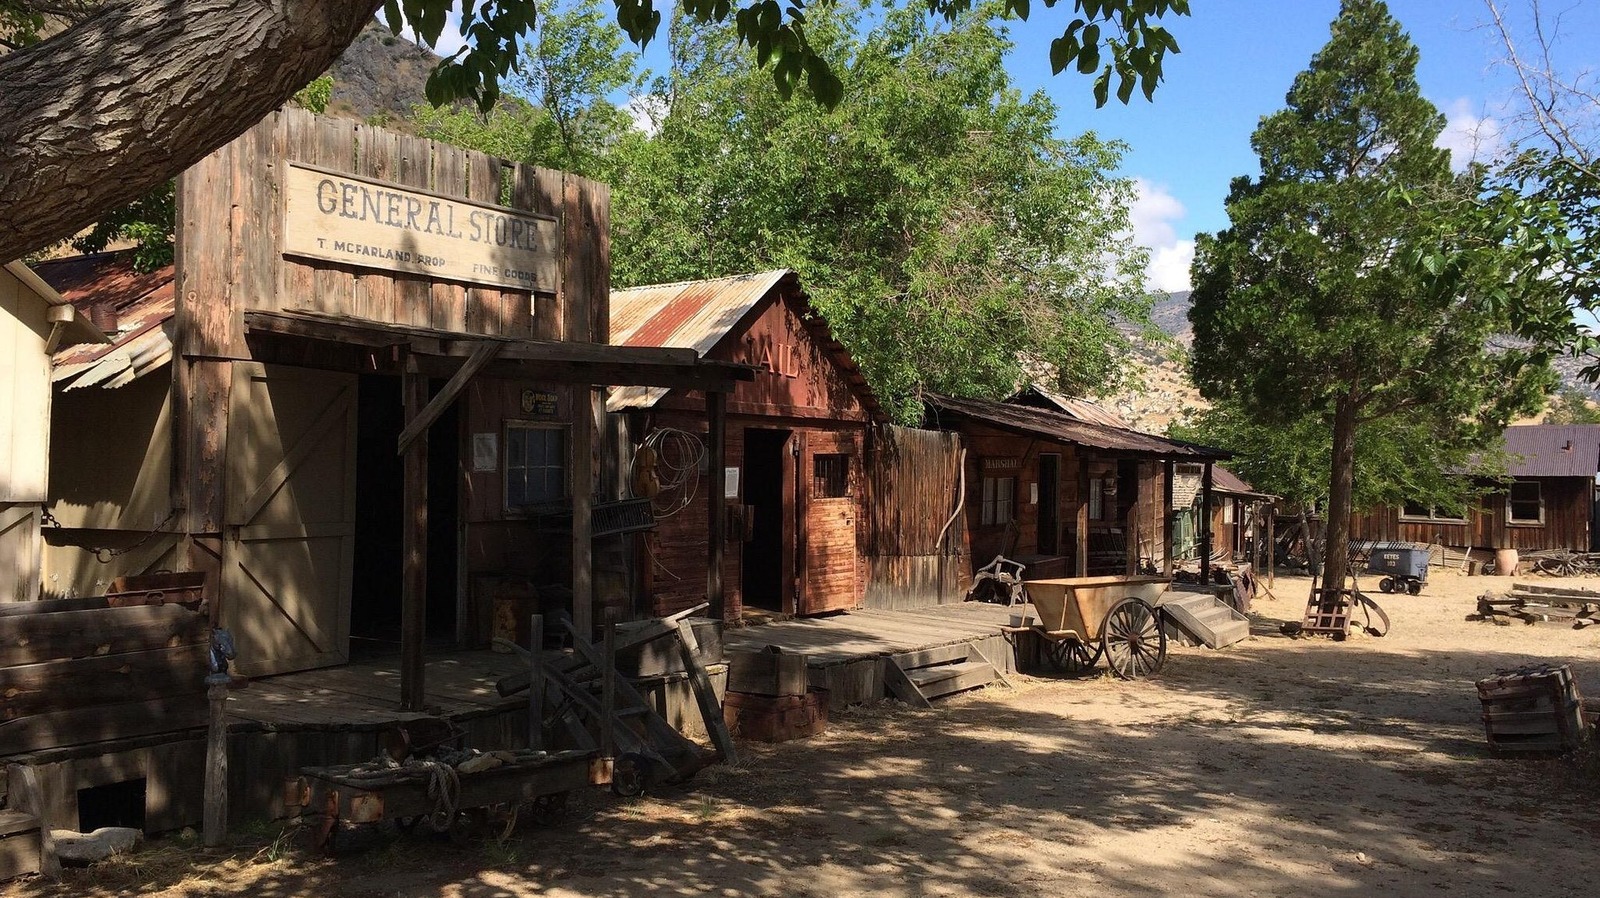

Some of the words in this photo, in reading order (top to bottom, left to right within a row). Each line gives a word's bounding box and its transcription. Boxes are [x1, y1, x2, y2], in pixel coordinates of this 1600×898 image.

[317, 179, 462, 238] GENERAL
[469, 210, 538, 251] STORE
[473, 263, 498, 276] FINE
[504, 268, 537, 282] GOODS
